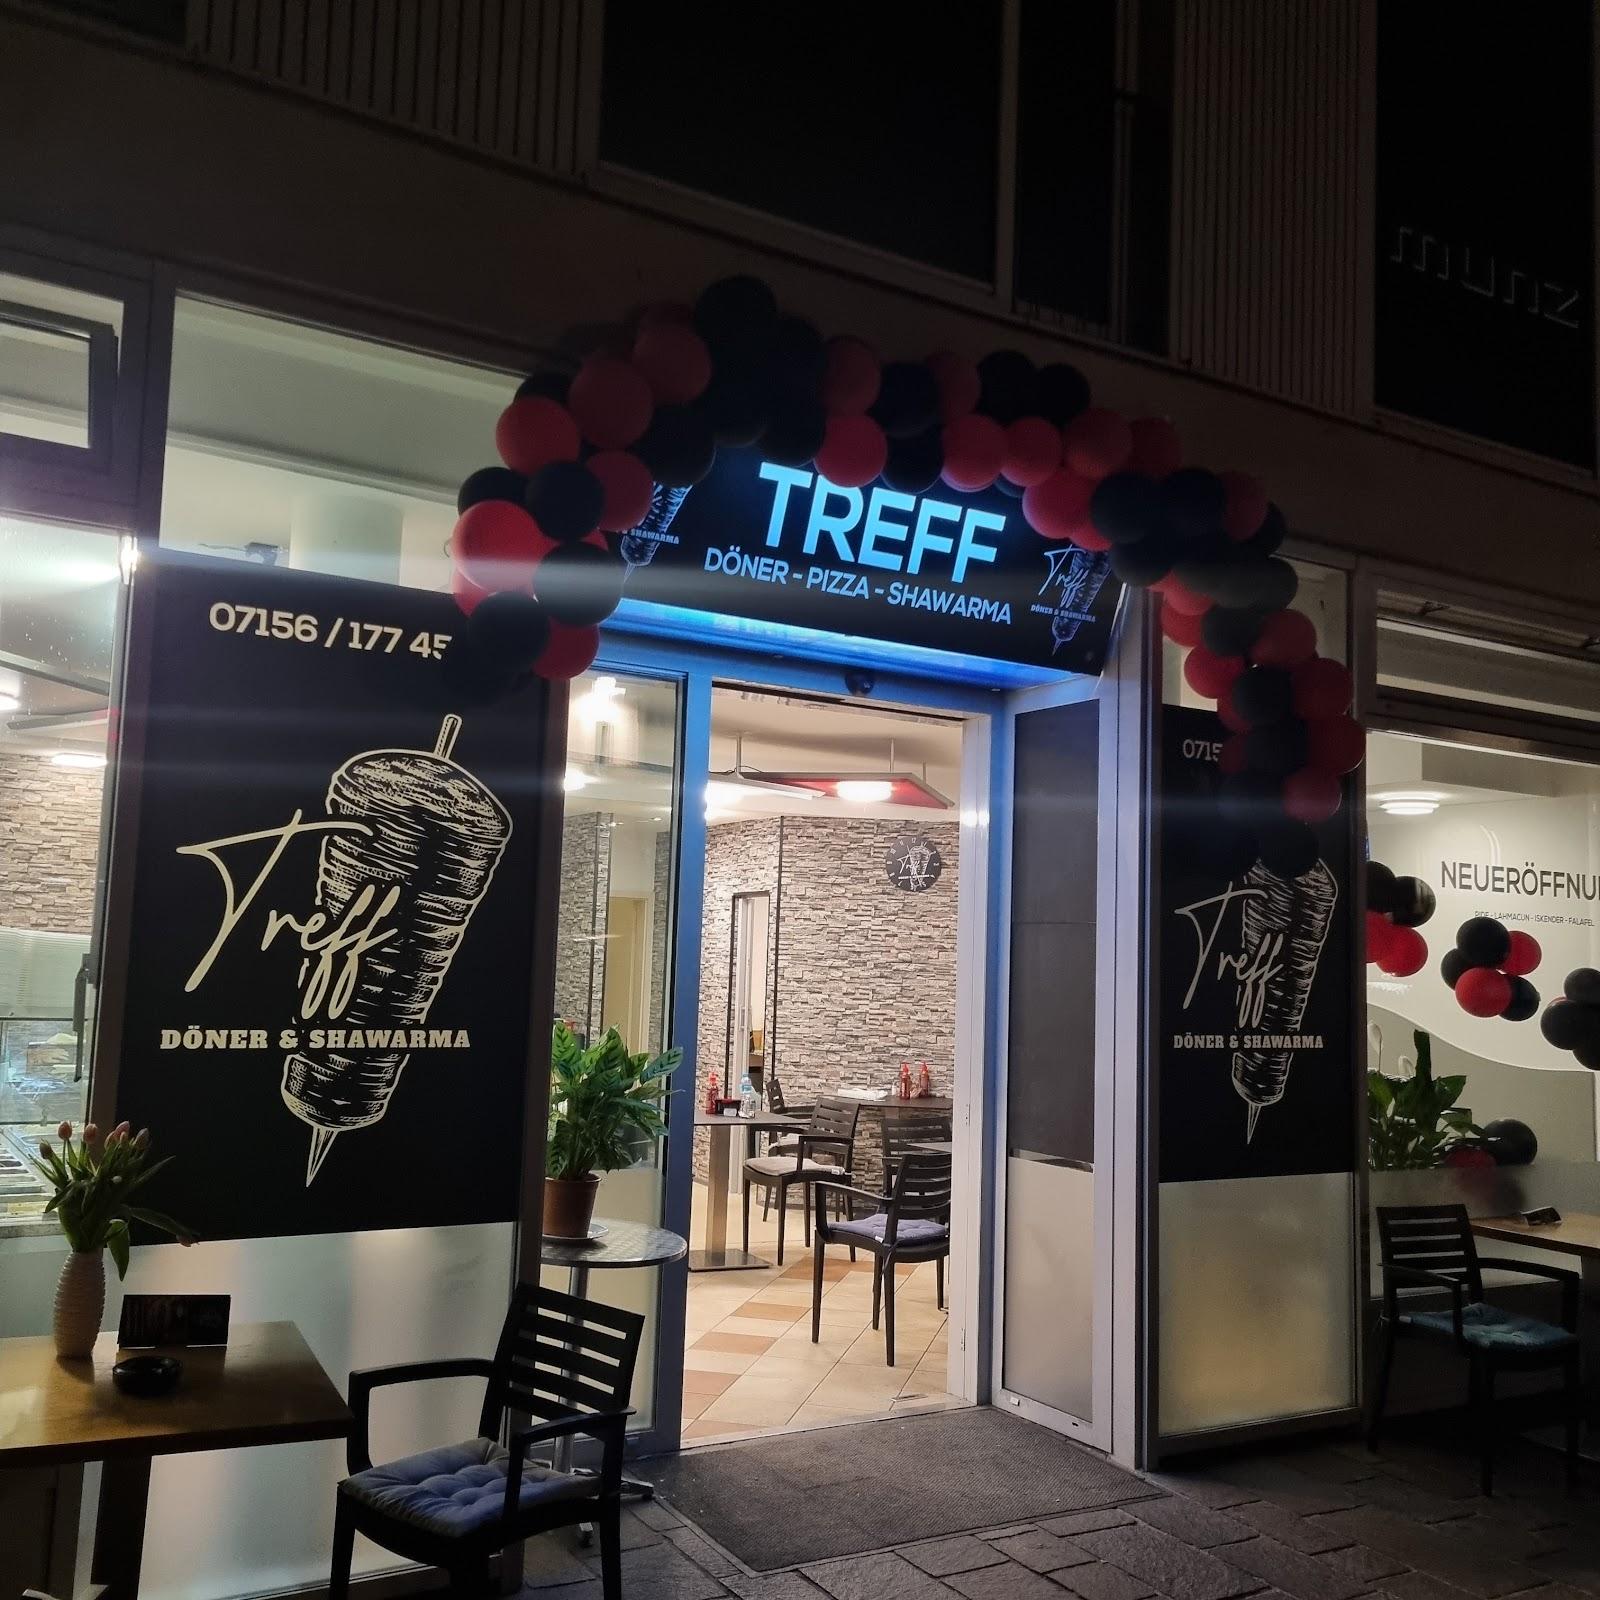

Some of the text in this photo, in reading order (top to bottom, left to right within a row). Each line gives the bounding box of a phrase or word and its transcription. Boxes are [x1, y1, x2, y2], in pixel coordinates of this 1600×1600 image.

[630, 528, 680, 544] SHAWARMA
[758, 461, 1006, 583] TREFF
[703, 545, 790, 585] DÖNER
[806, 570, 869, 600] PIZZA
[886, 581, 1013, 625] SHAWARMA
[1038, 544, 1089, 609] Treff
[208, 601, 318, 643] 07156
[325, 618, 342, 648] /
[347, 621, 403, 655] 177
[1441, 861, 1600, 901] NEUERÖFFNU
[176, 809, 402, 1020] Treff
[1494, 912, 1530, 921] LAHMACUN
[1535, 915, 1564, 923] ISKENDER
[1569, 917, 1595, 927] FALAFEL
[1174, 880, 1283, 1029] Treff
[160, 1026, 471, 1051] DÖNER & SHAWARMA
[1173, 1031, 1324, 1049] DÖNER & SHAWARMA
